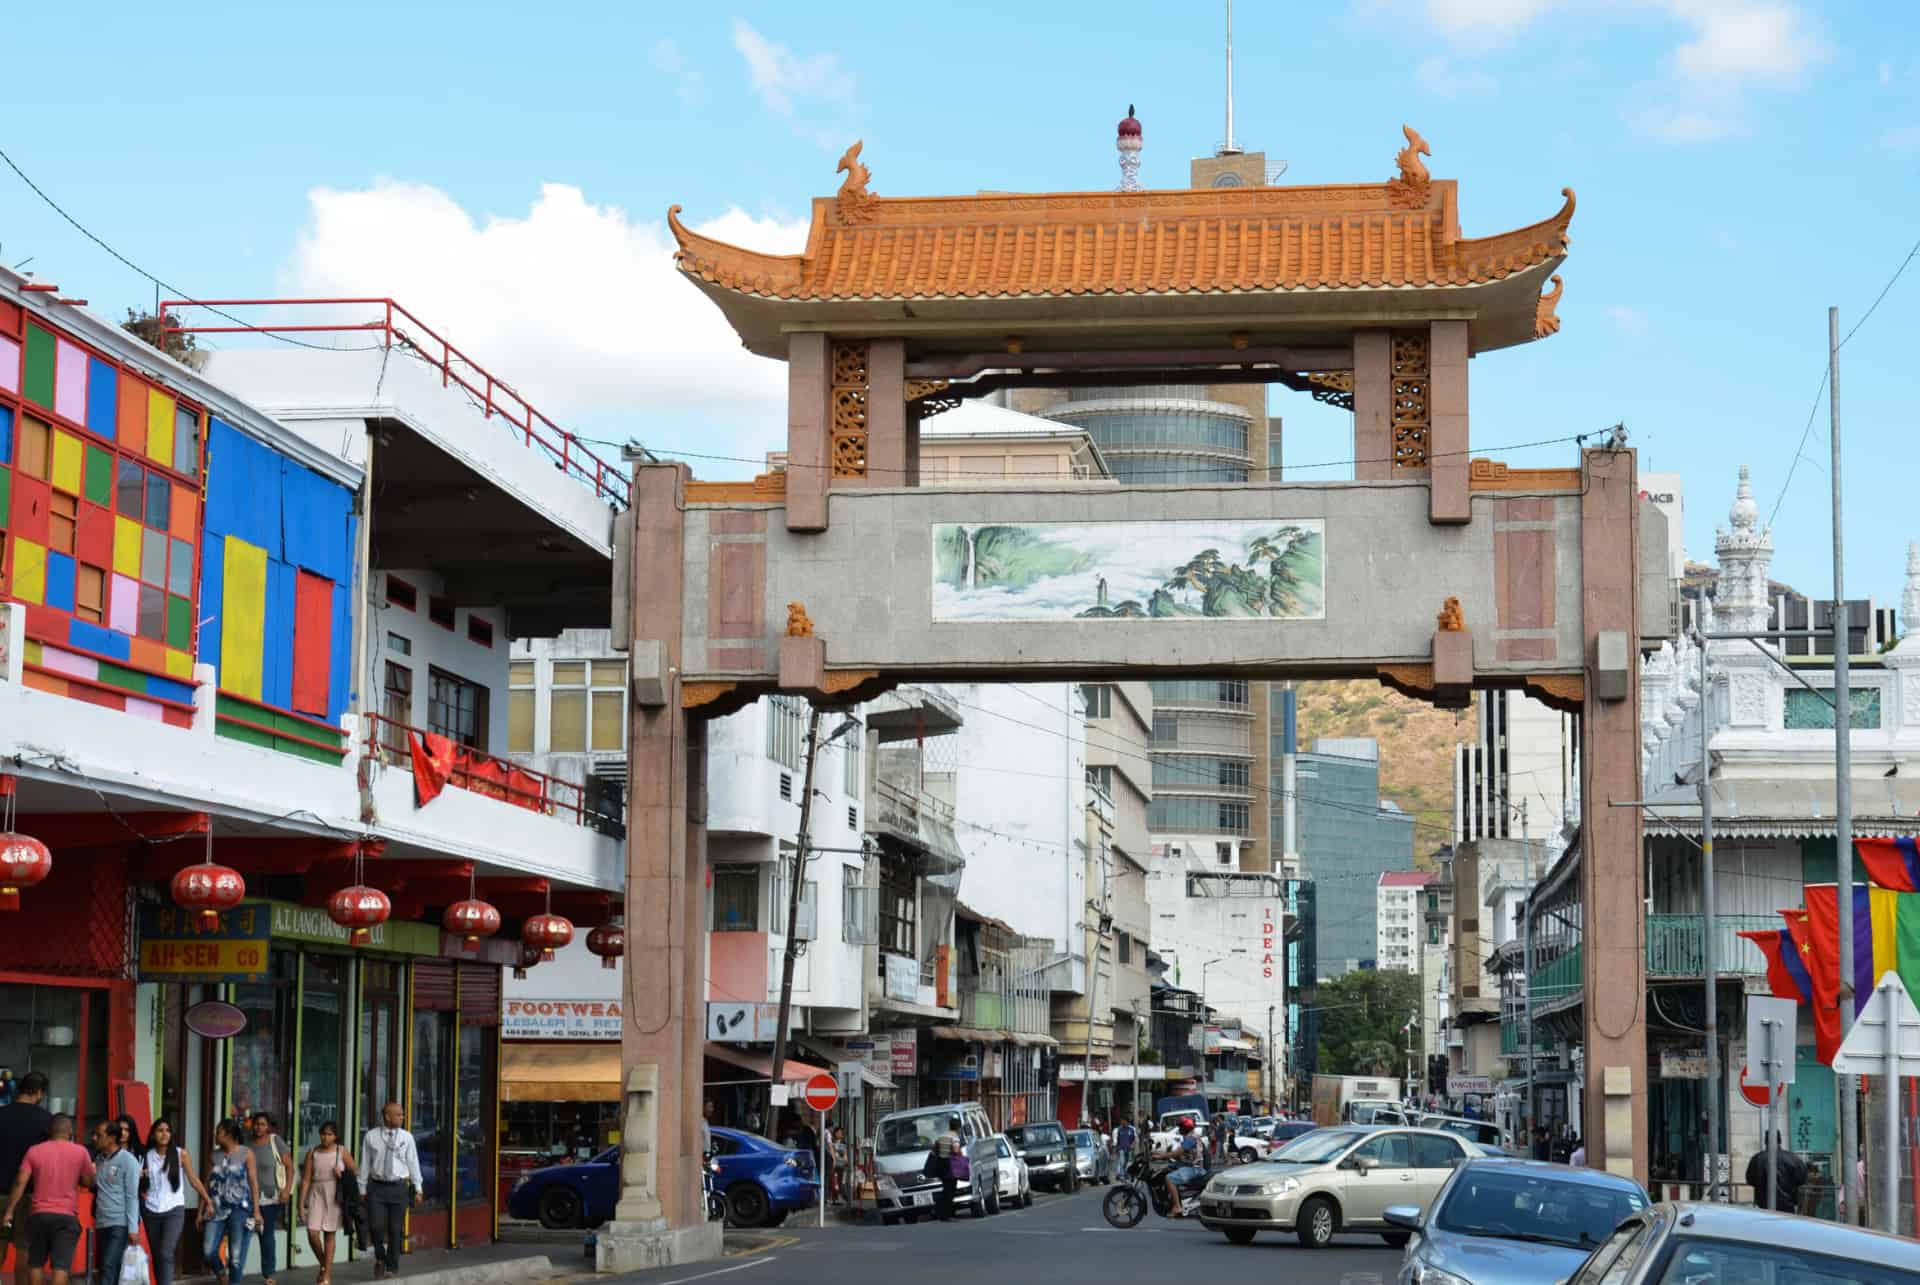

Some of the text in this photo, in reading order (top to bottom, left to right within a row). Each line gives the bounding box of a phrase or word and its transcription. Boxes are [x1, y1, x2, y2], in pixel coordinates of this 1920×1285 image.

[1648, 493, 1674, 503] MCB
[1263, 908, 1274, 978] IDEAS
[503, 1018, 566, 1029] LESALER
